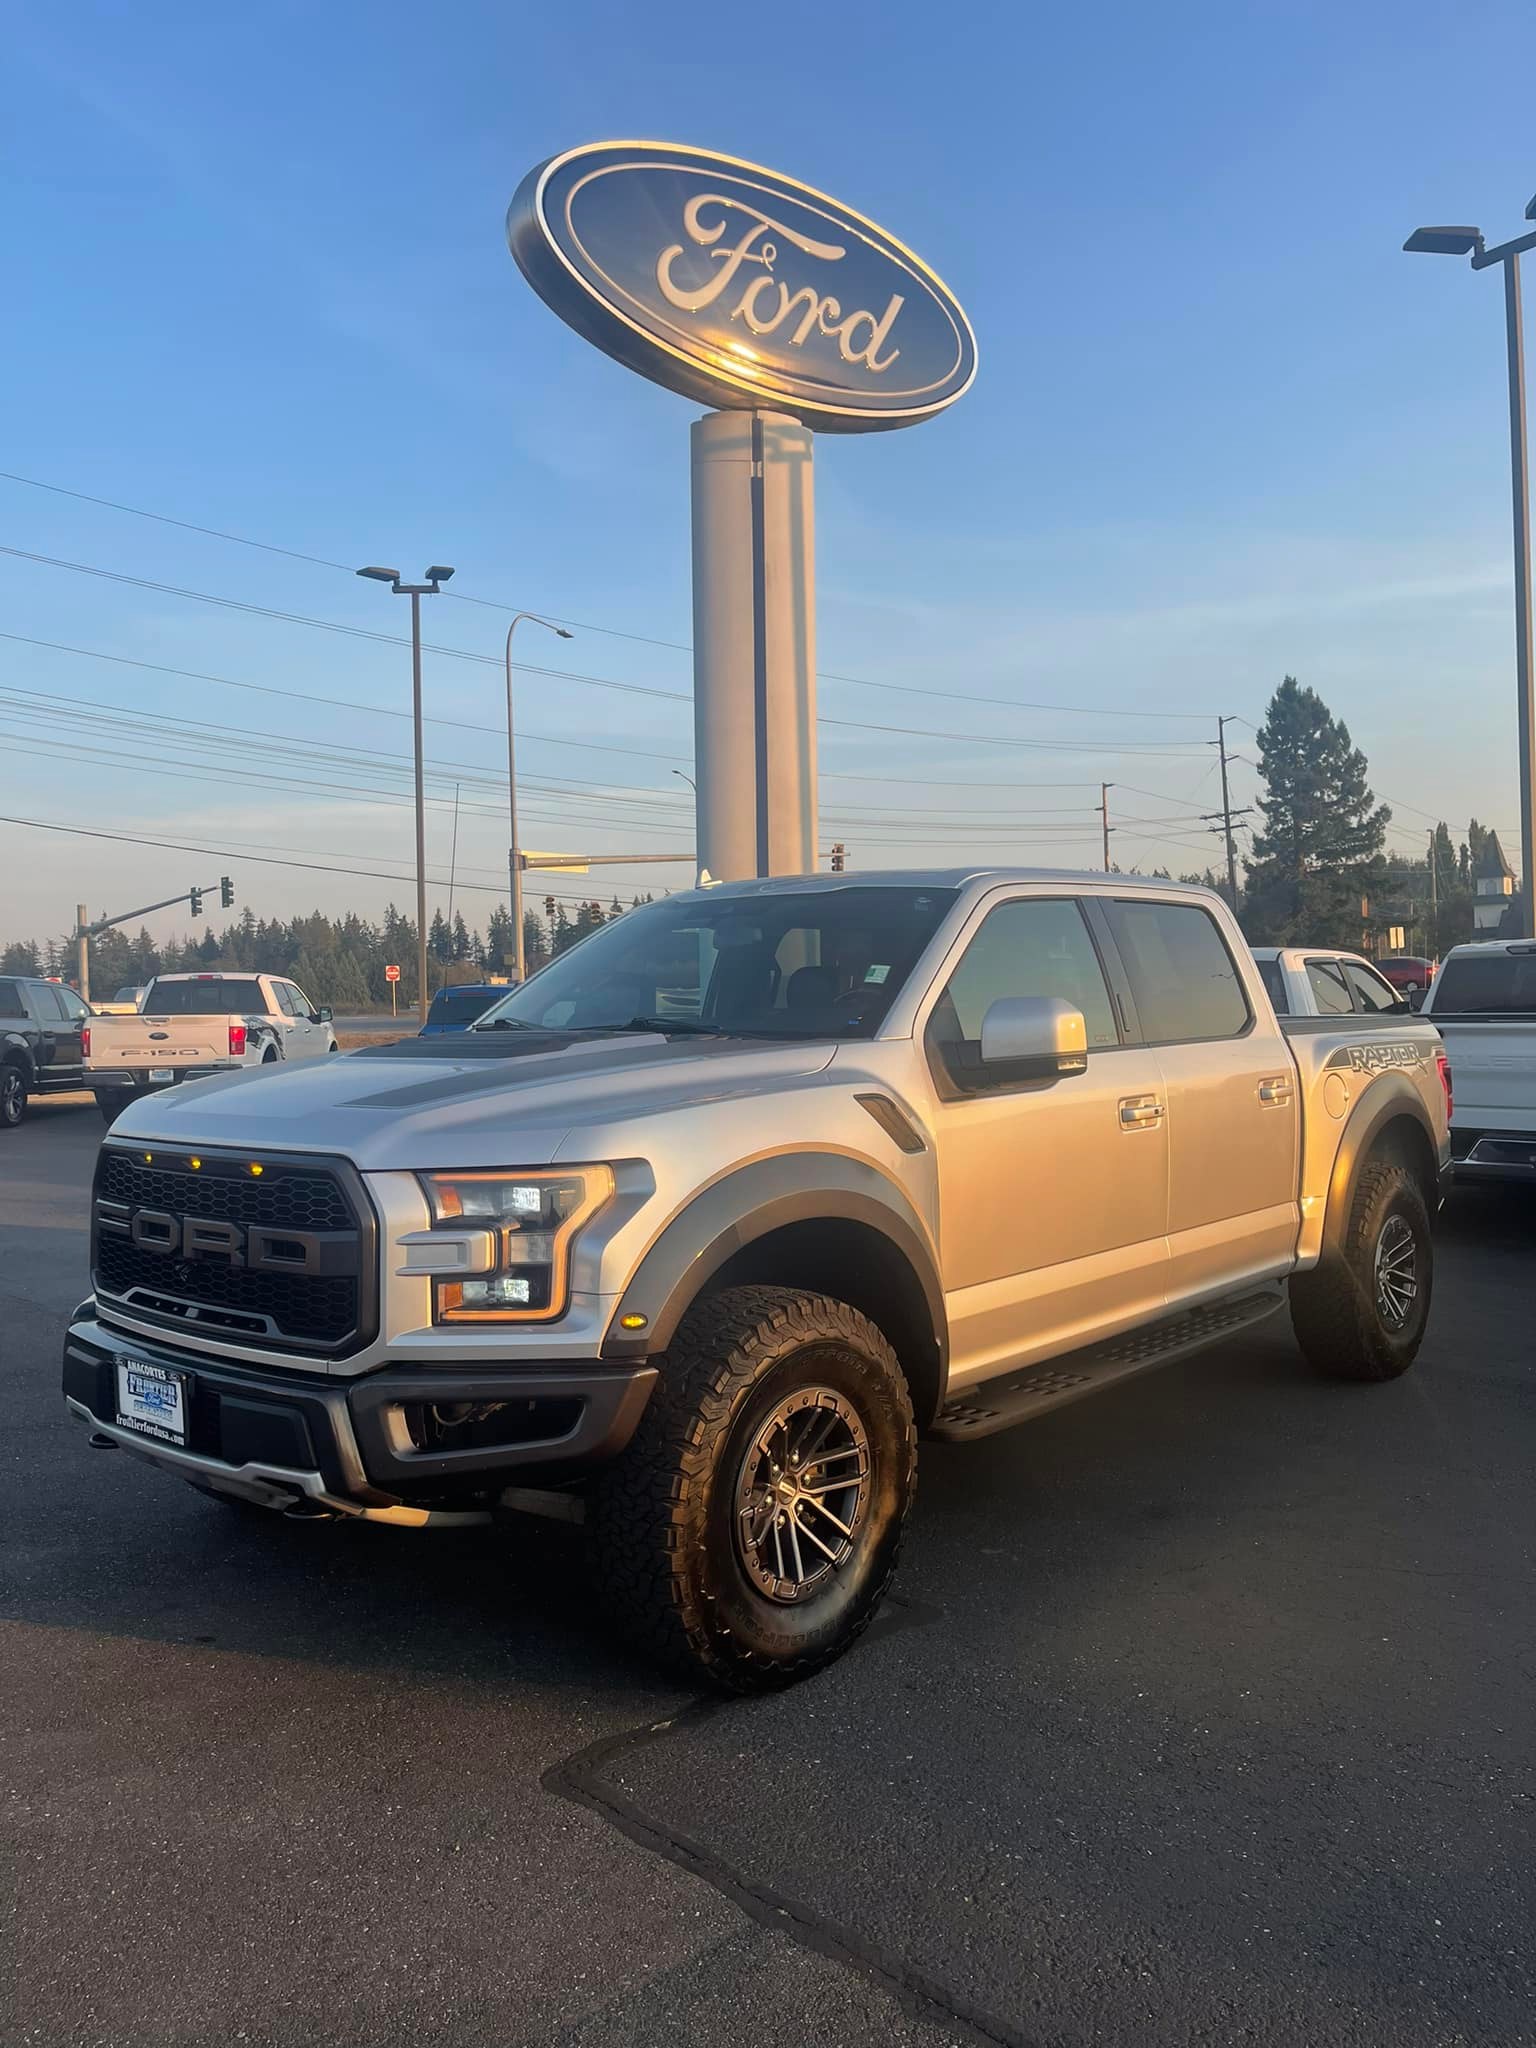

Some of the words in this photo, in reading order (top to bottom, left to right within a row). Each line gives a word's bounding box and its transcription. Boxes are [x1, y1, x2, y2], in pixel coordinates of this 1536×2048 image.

[657, 194, 904, 371] Ford
[121, 1048, 199, 1057] F-150
[1348, 1044, 1426, 1076] RAPTOR
[127, 1360, 167, 1380] ANACORTES
[116, 1413, 185, 1446] frontierfordusa.com
